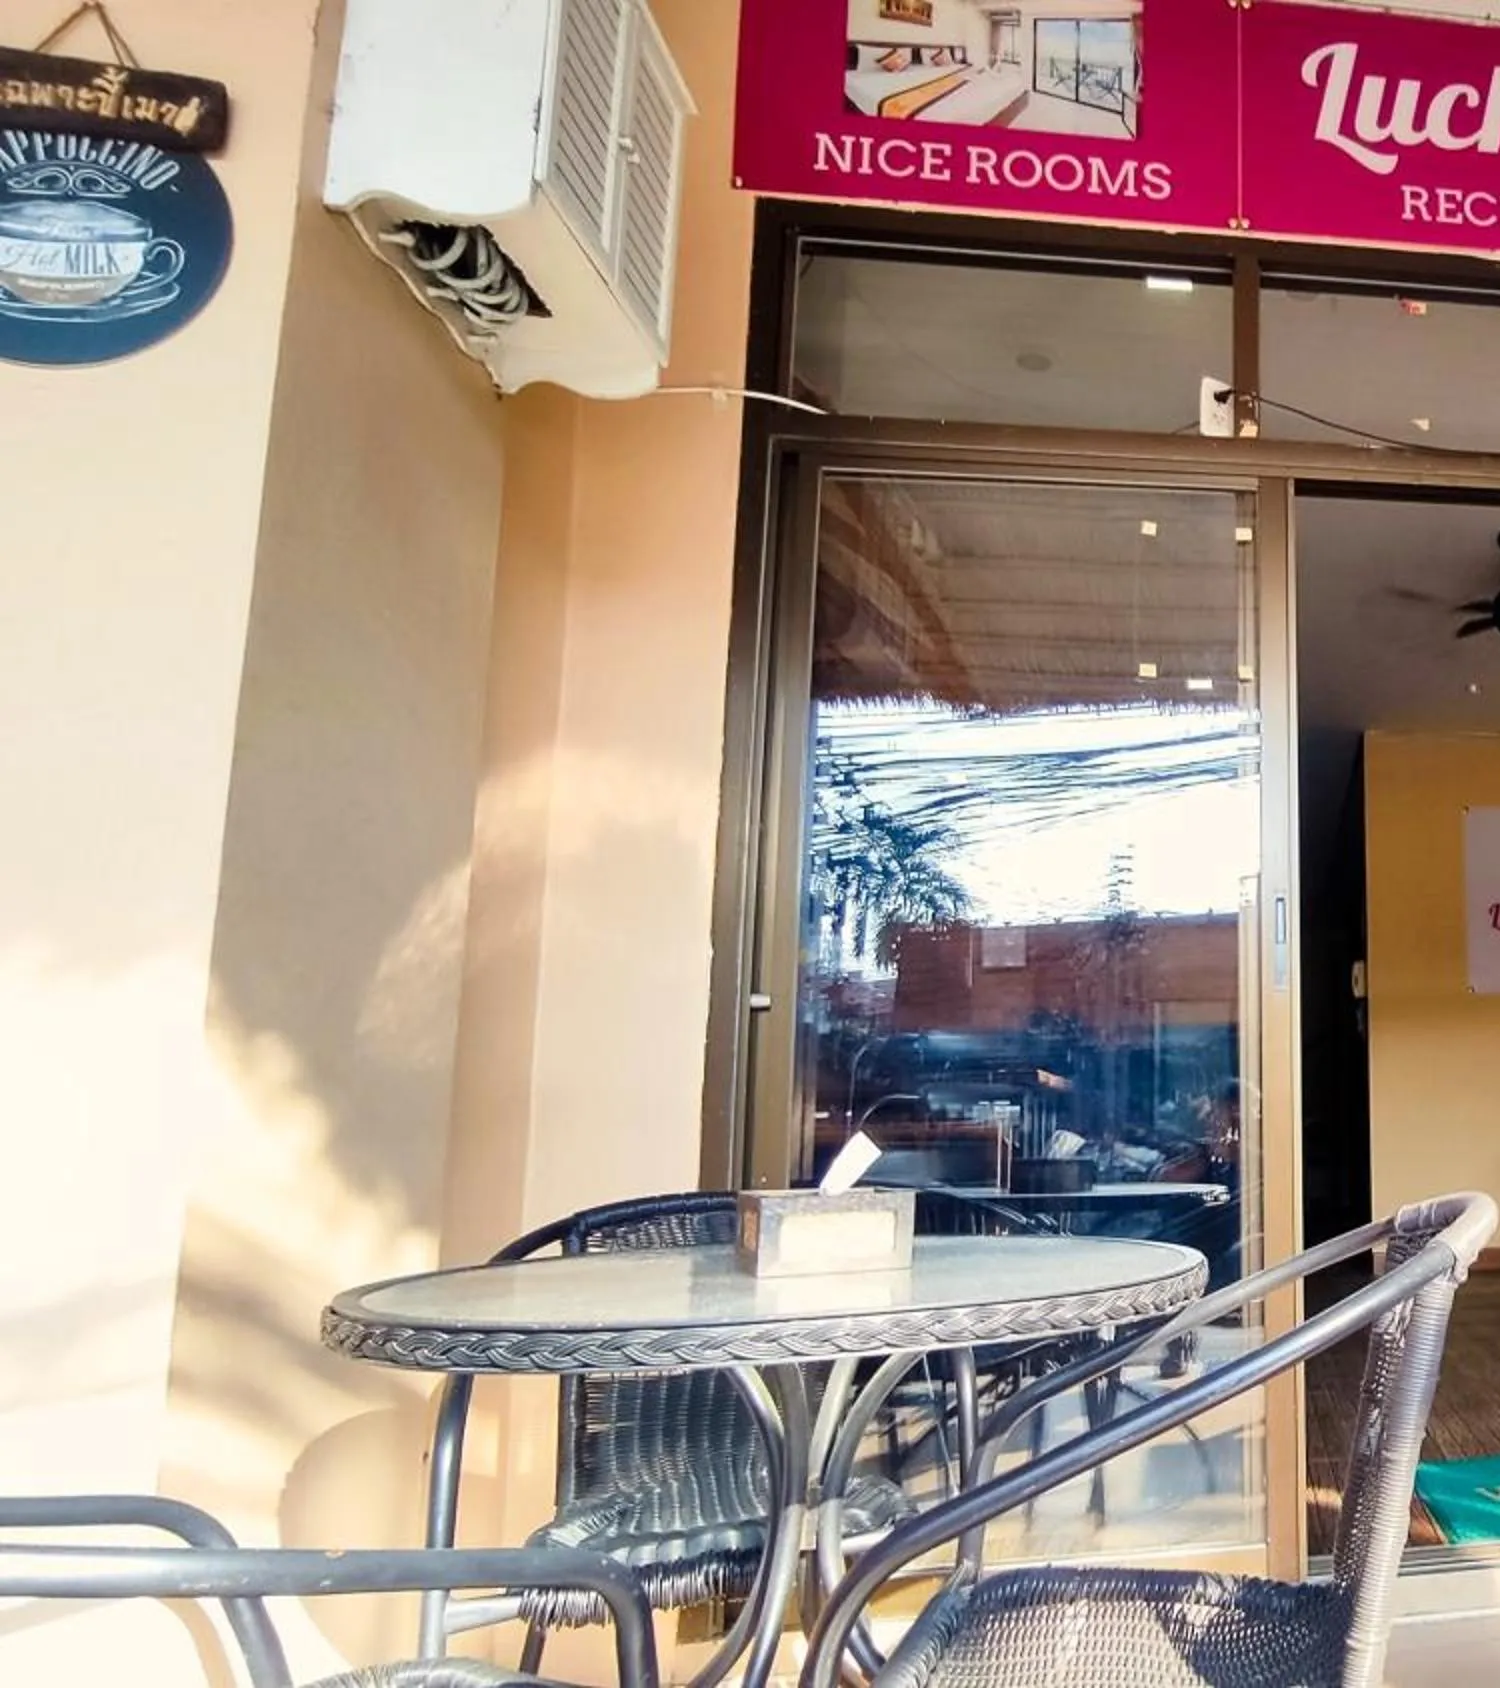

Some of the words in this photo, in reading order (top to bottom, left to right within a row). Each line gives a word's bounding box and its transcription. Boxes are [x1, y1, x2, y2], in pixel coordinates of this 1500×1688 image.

[813, 132, 952, 182] NICE
[966, 146, 1173, 200] ROOMS
[64, 243, 121, 275] MILK
